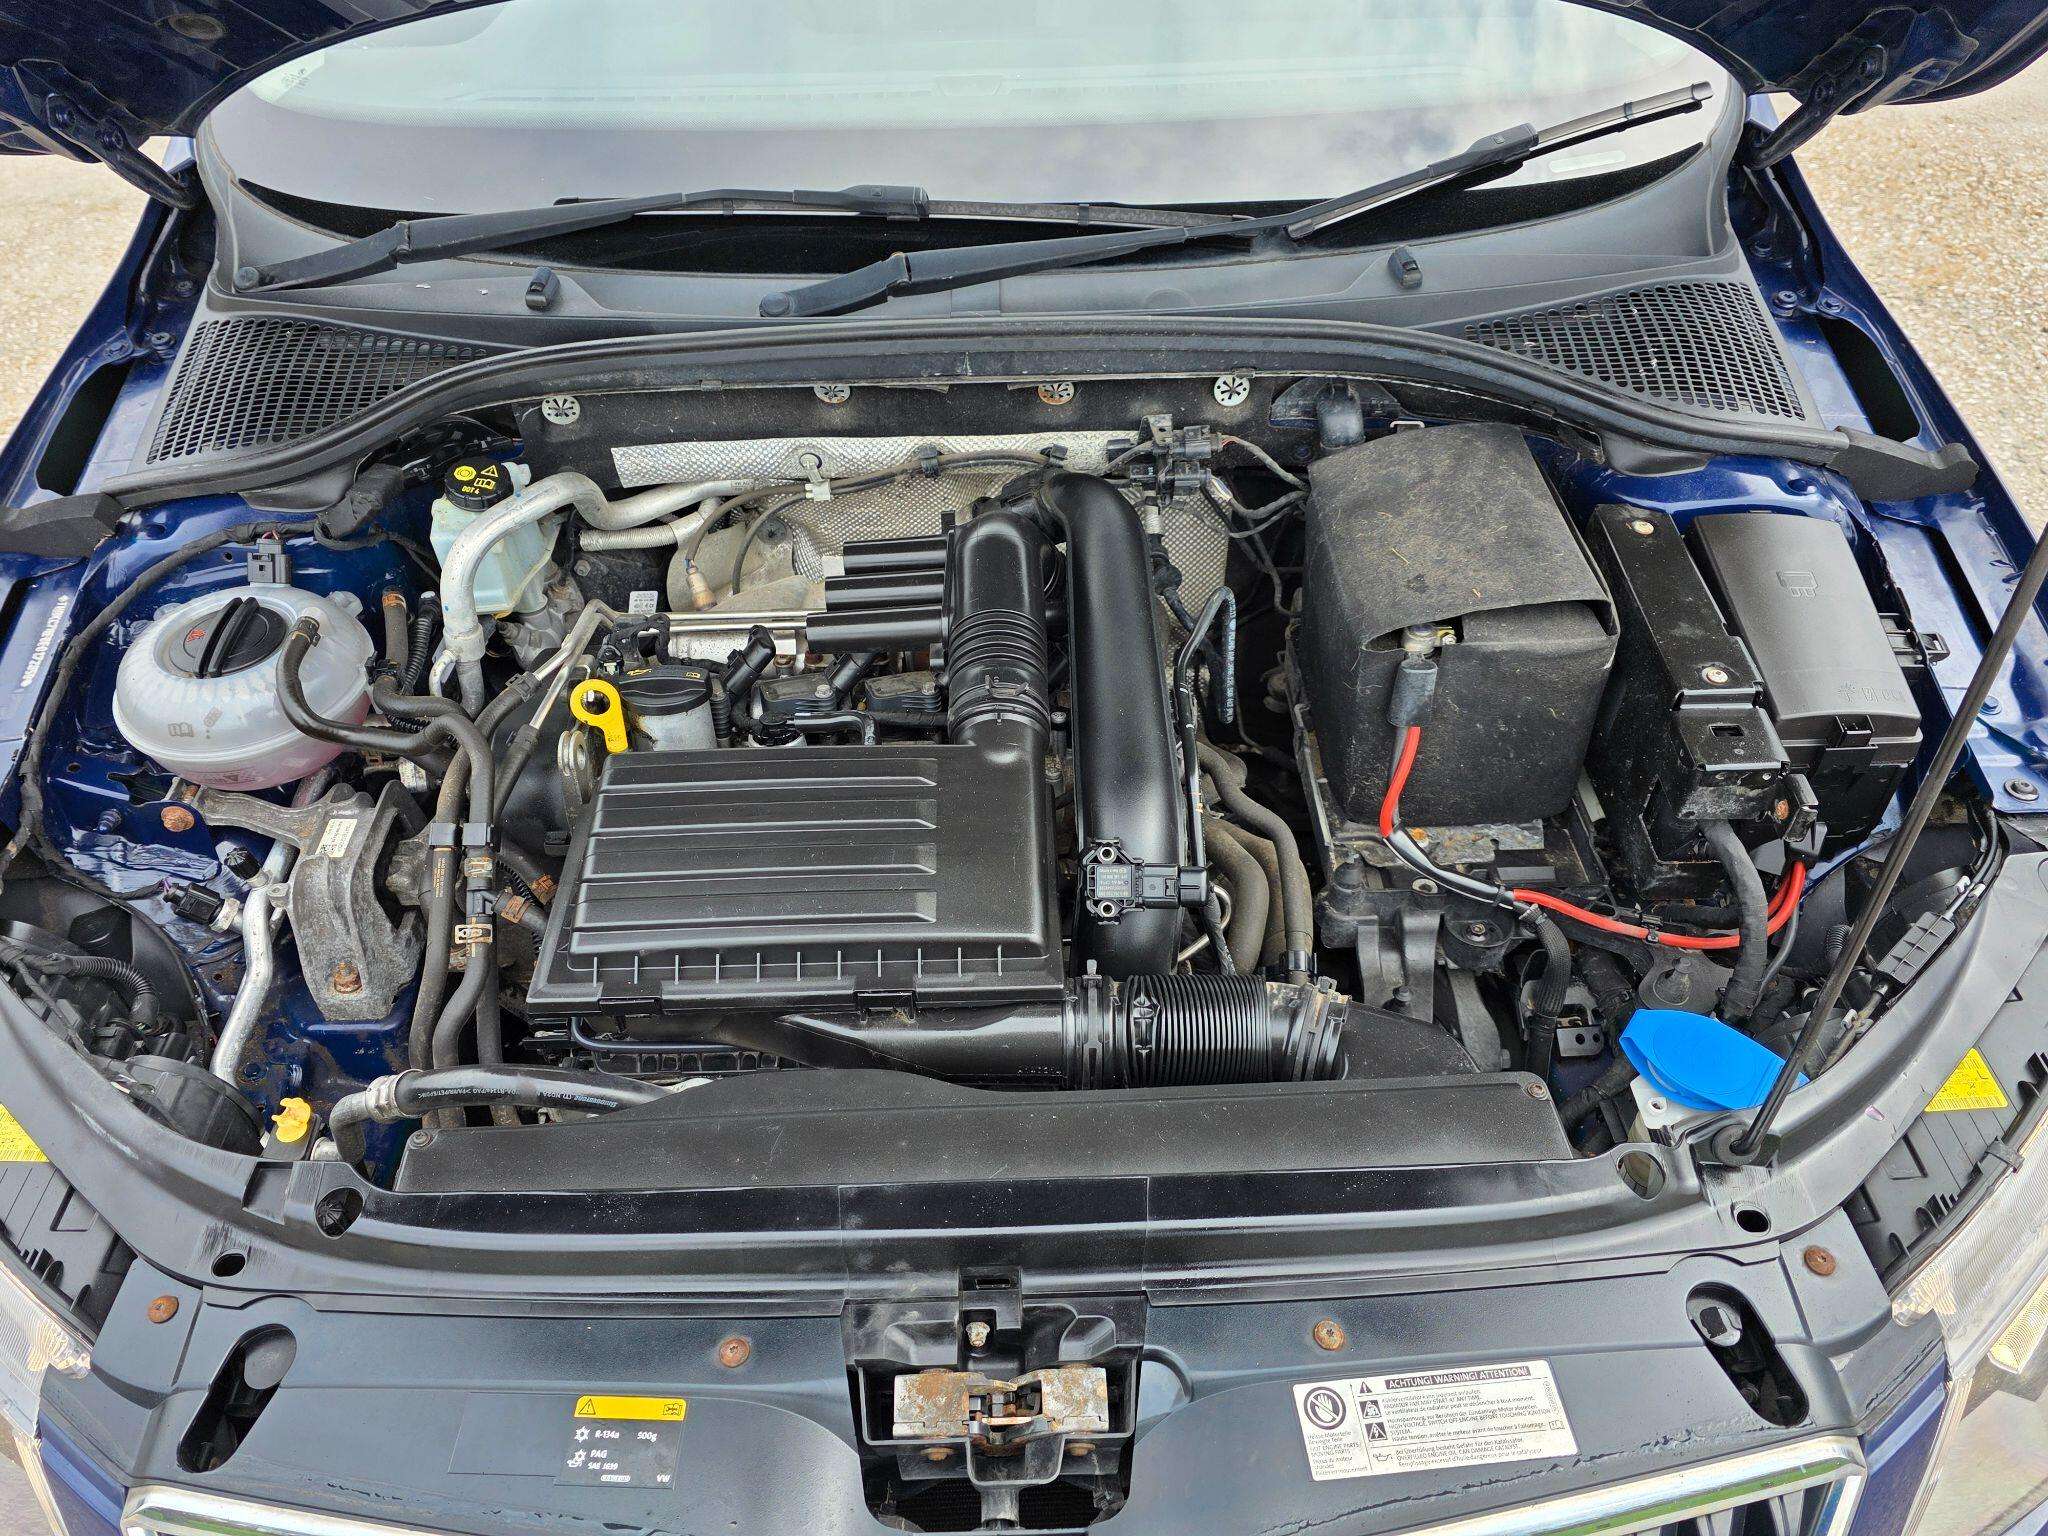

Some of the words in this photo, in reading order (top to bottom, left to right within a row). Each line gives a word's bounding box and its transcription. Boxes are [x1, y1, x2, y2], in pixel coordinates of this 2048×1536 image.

[1389, 1376, 1432, 1388] ACHTUNG!
[1434, 1371, 1478, 1384] WARNING!
[1480, 1366, 1528, 1380] ATTENTION!
[590, 1449, 608, 1459] PAG
